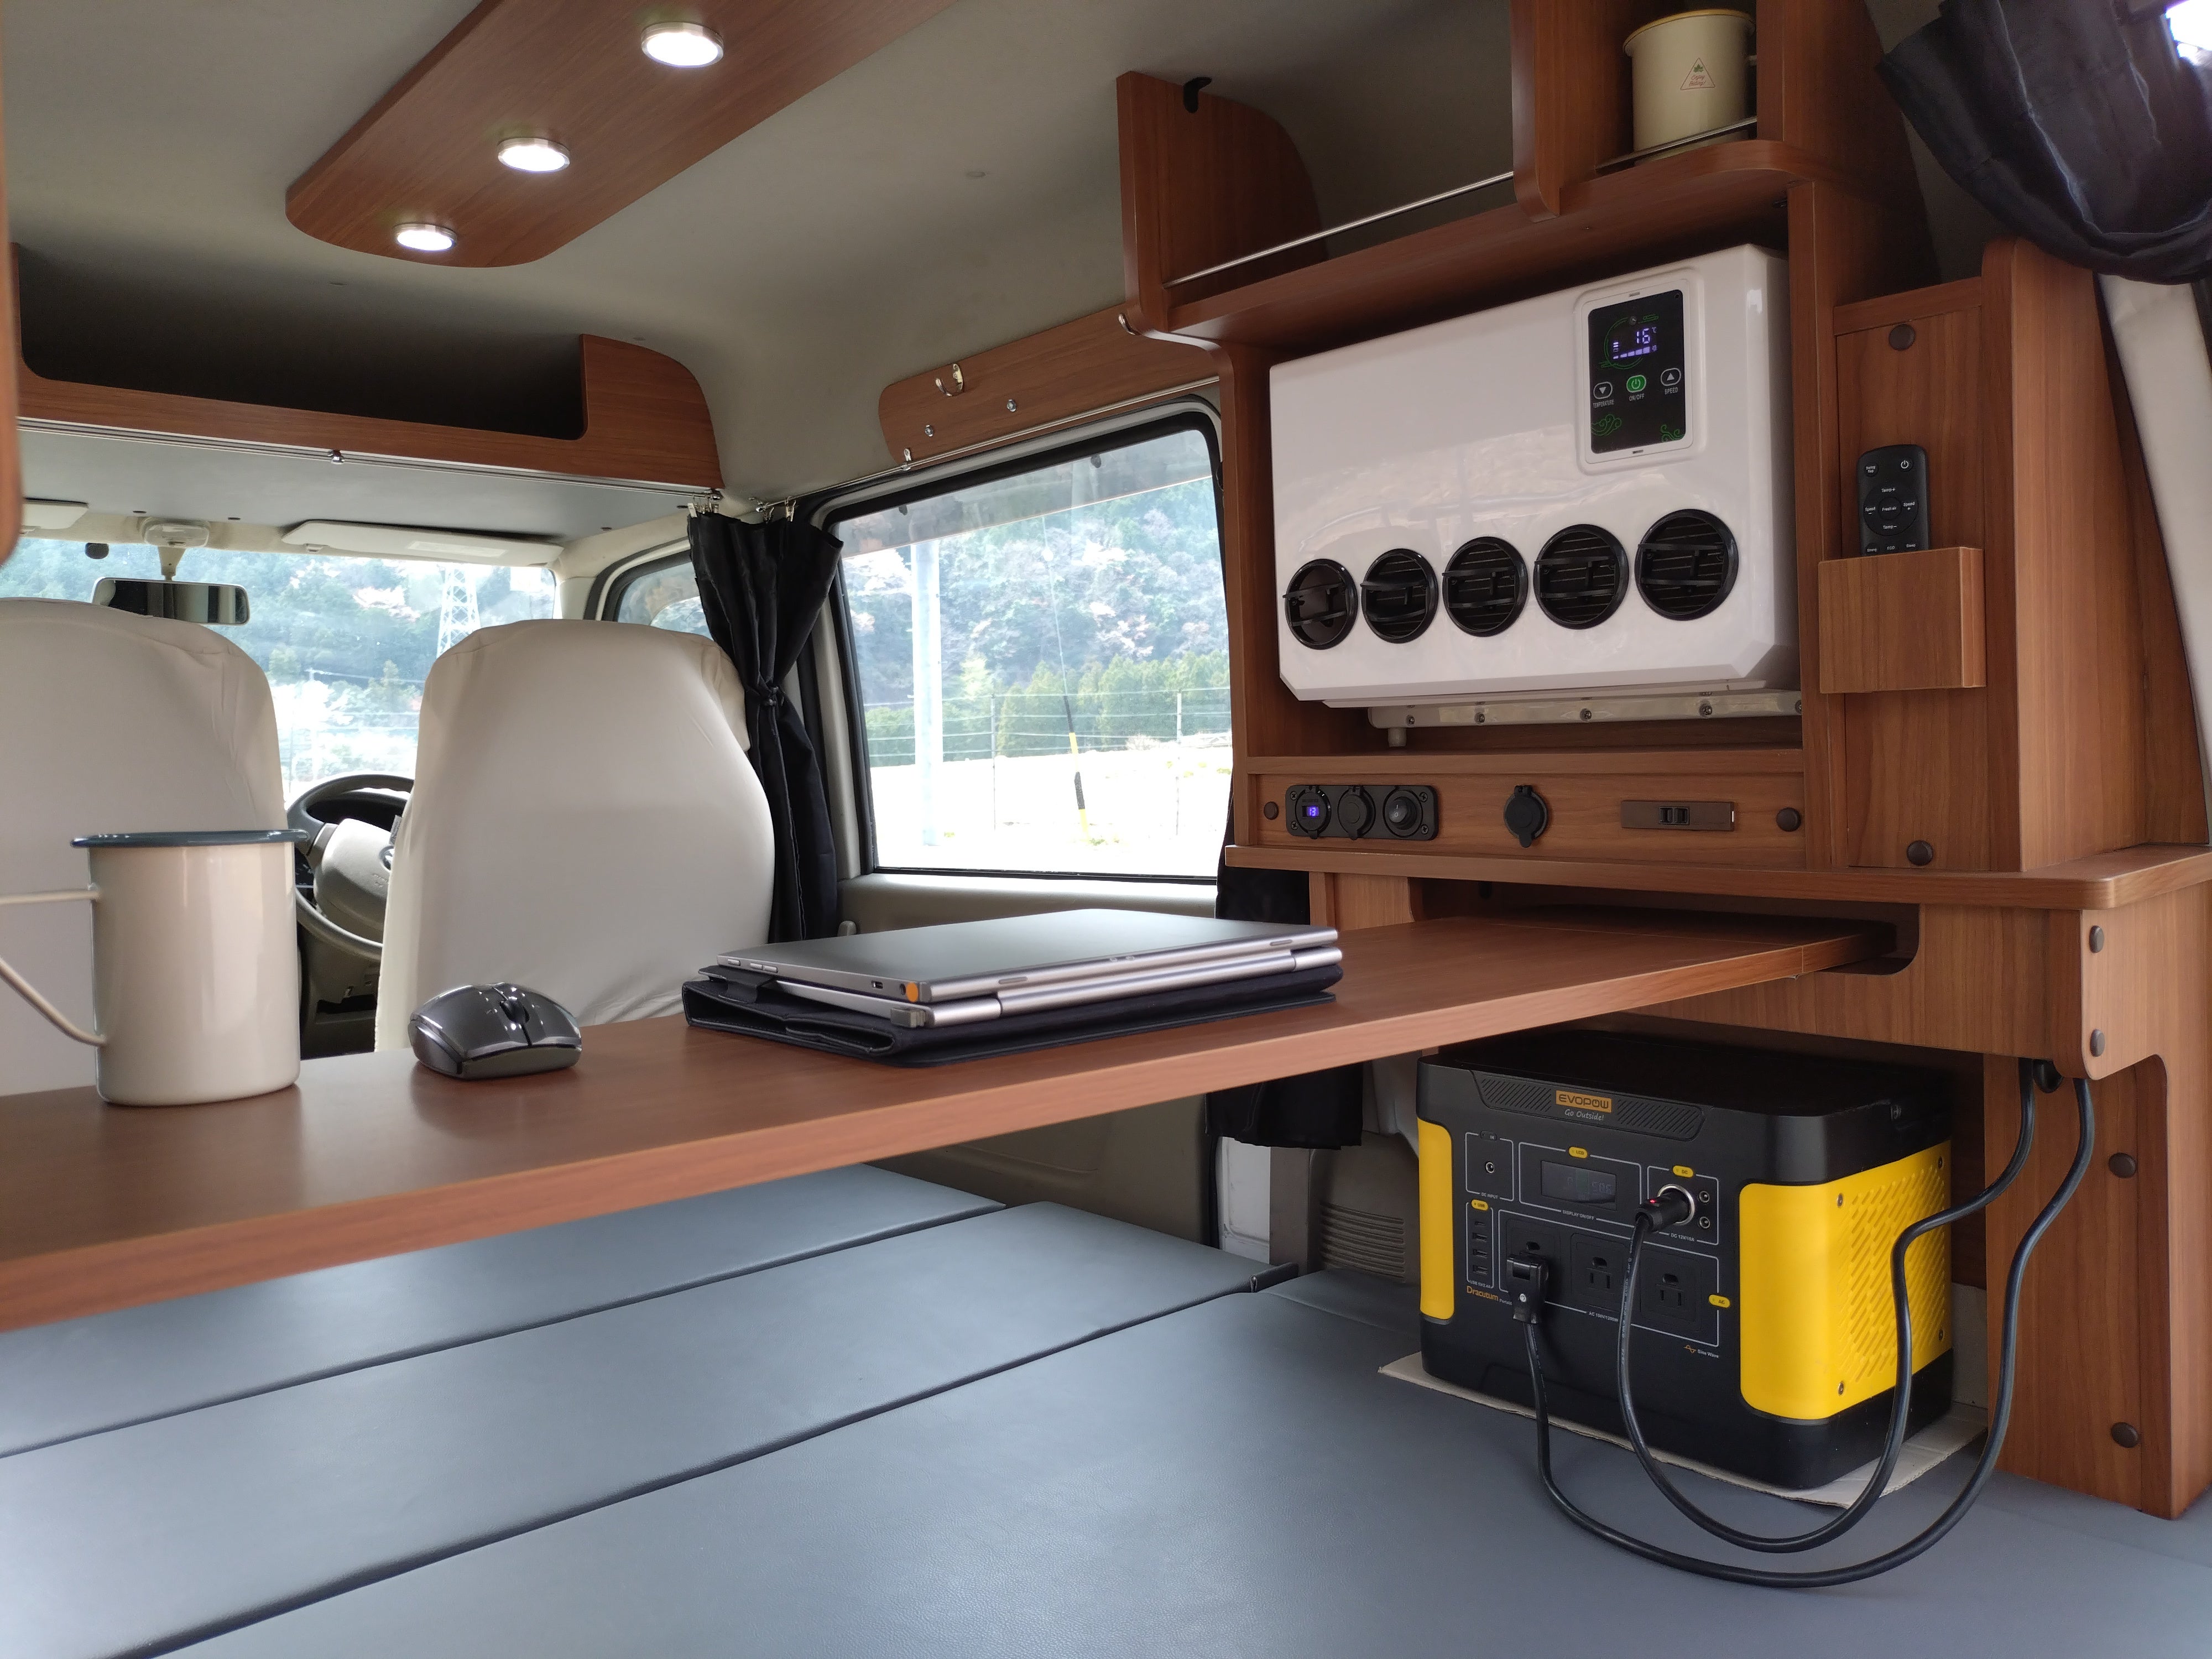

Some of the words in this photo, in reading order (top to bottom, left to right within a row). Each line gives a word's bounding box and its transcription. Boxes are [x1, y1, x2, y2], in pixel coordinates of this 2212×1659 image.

[1637, 328, 1650, 344] 16
[1629, 393, 1645, 401] ON/OFF
[1593, 399, 1614, 408] TEMPERATURE
[1558, 1094, 1609, 1109] EVOPOW
[1576, 1111, 1604, 1121] Outside!
